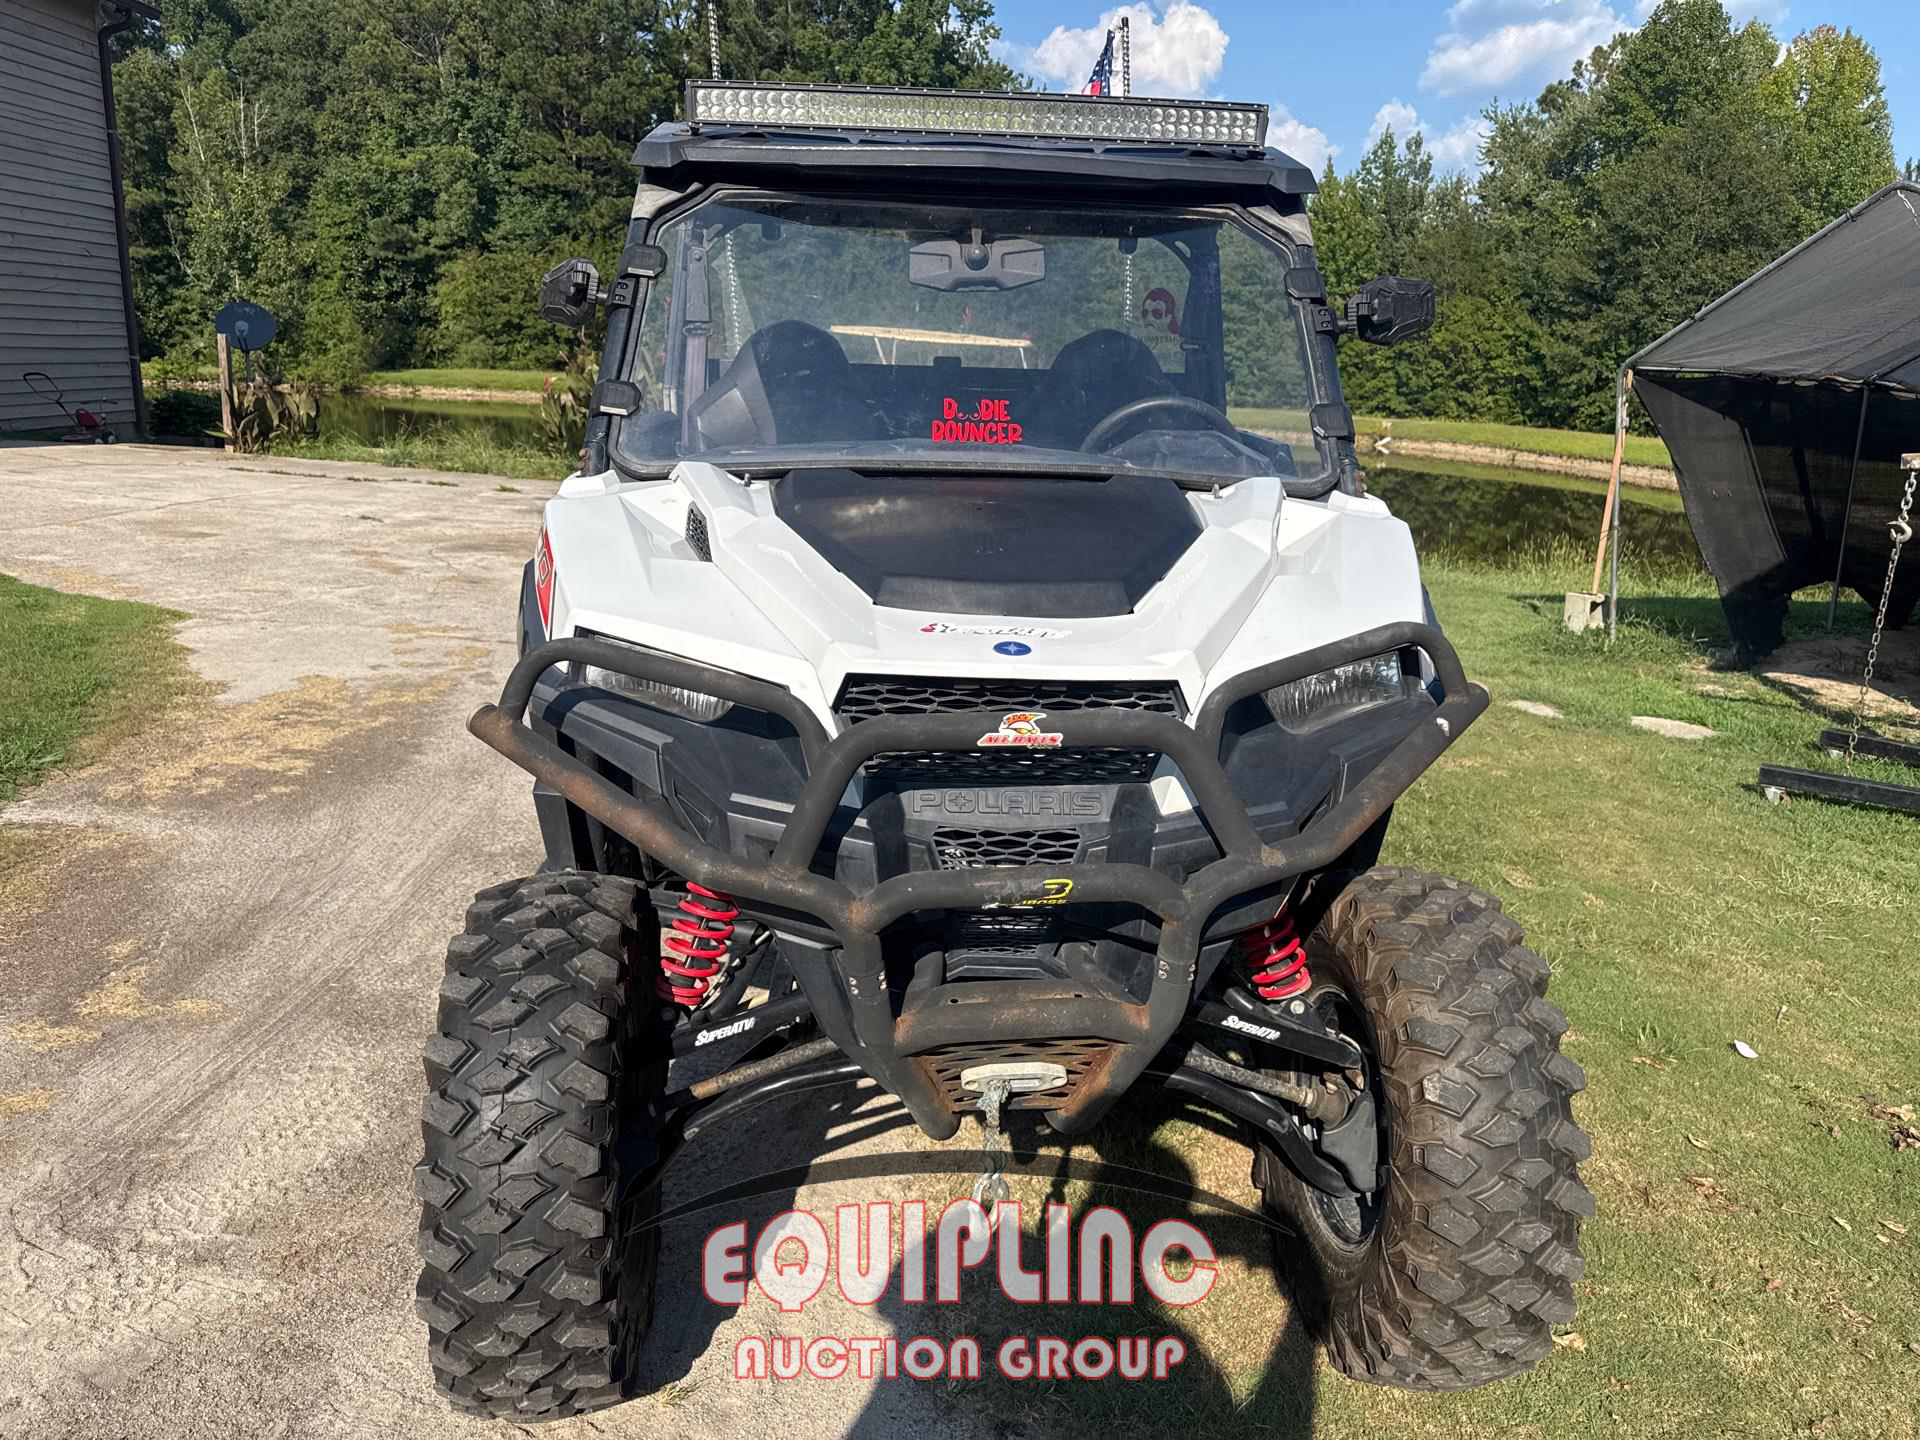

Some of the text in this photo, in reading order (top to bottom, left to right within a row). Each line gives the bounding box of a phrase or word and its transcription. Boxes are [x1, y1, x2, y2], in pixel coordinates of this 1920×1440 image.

[932, 420, 1023, 444] BOUNCER
[981, 734, 1010, 745] ALL
[913, 789, 1102, 816] POLARIS
